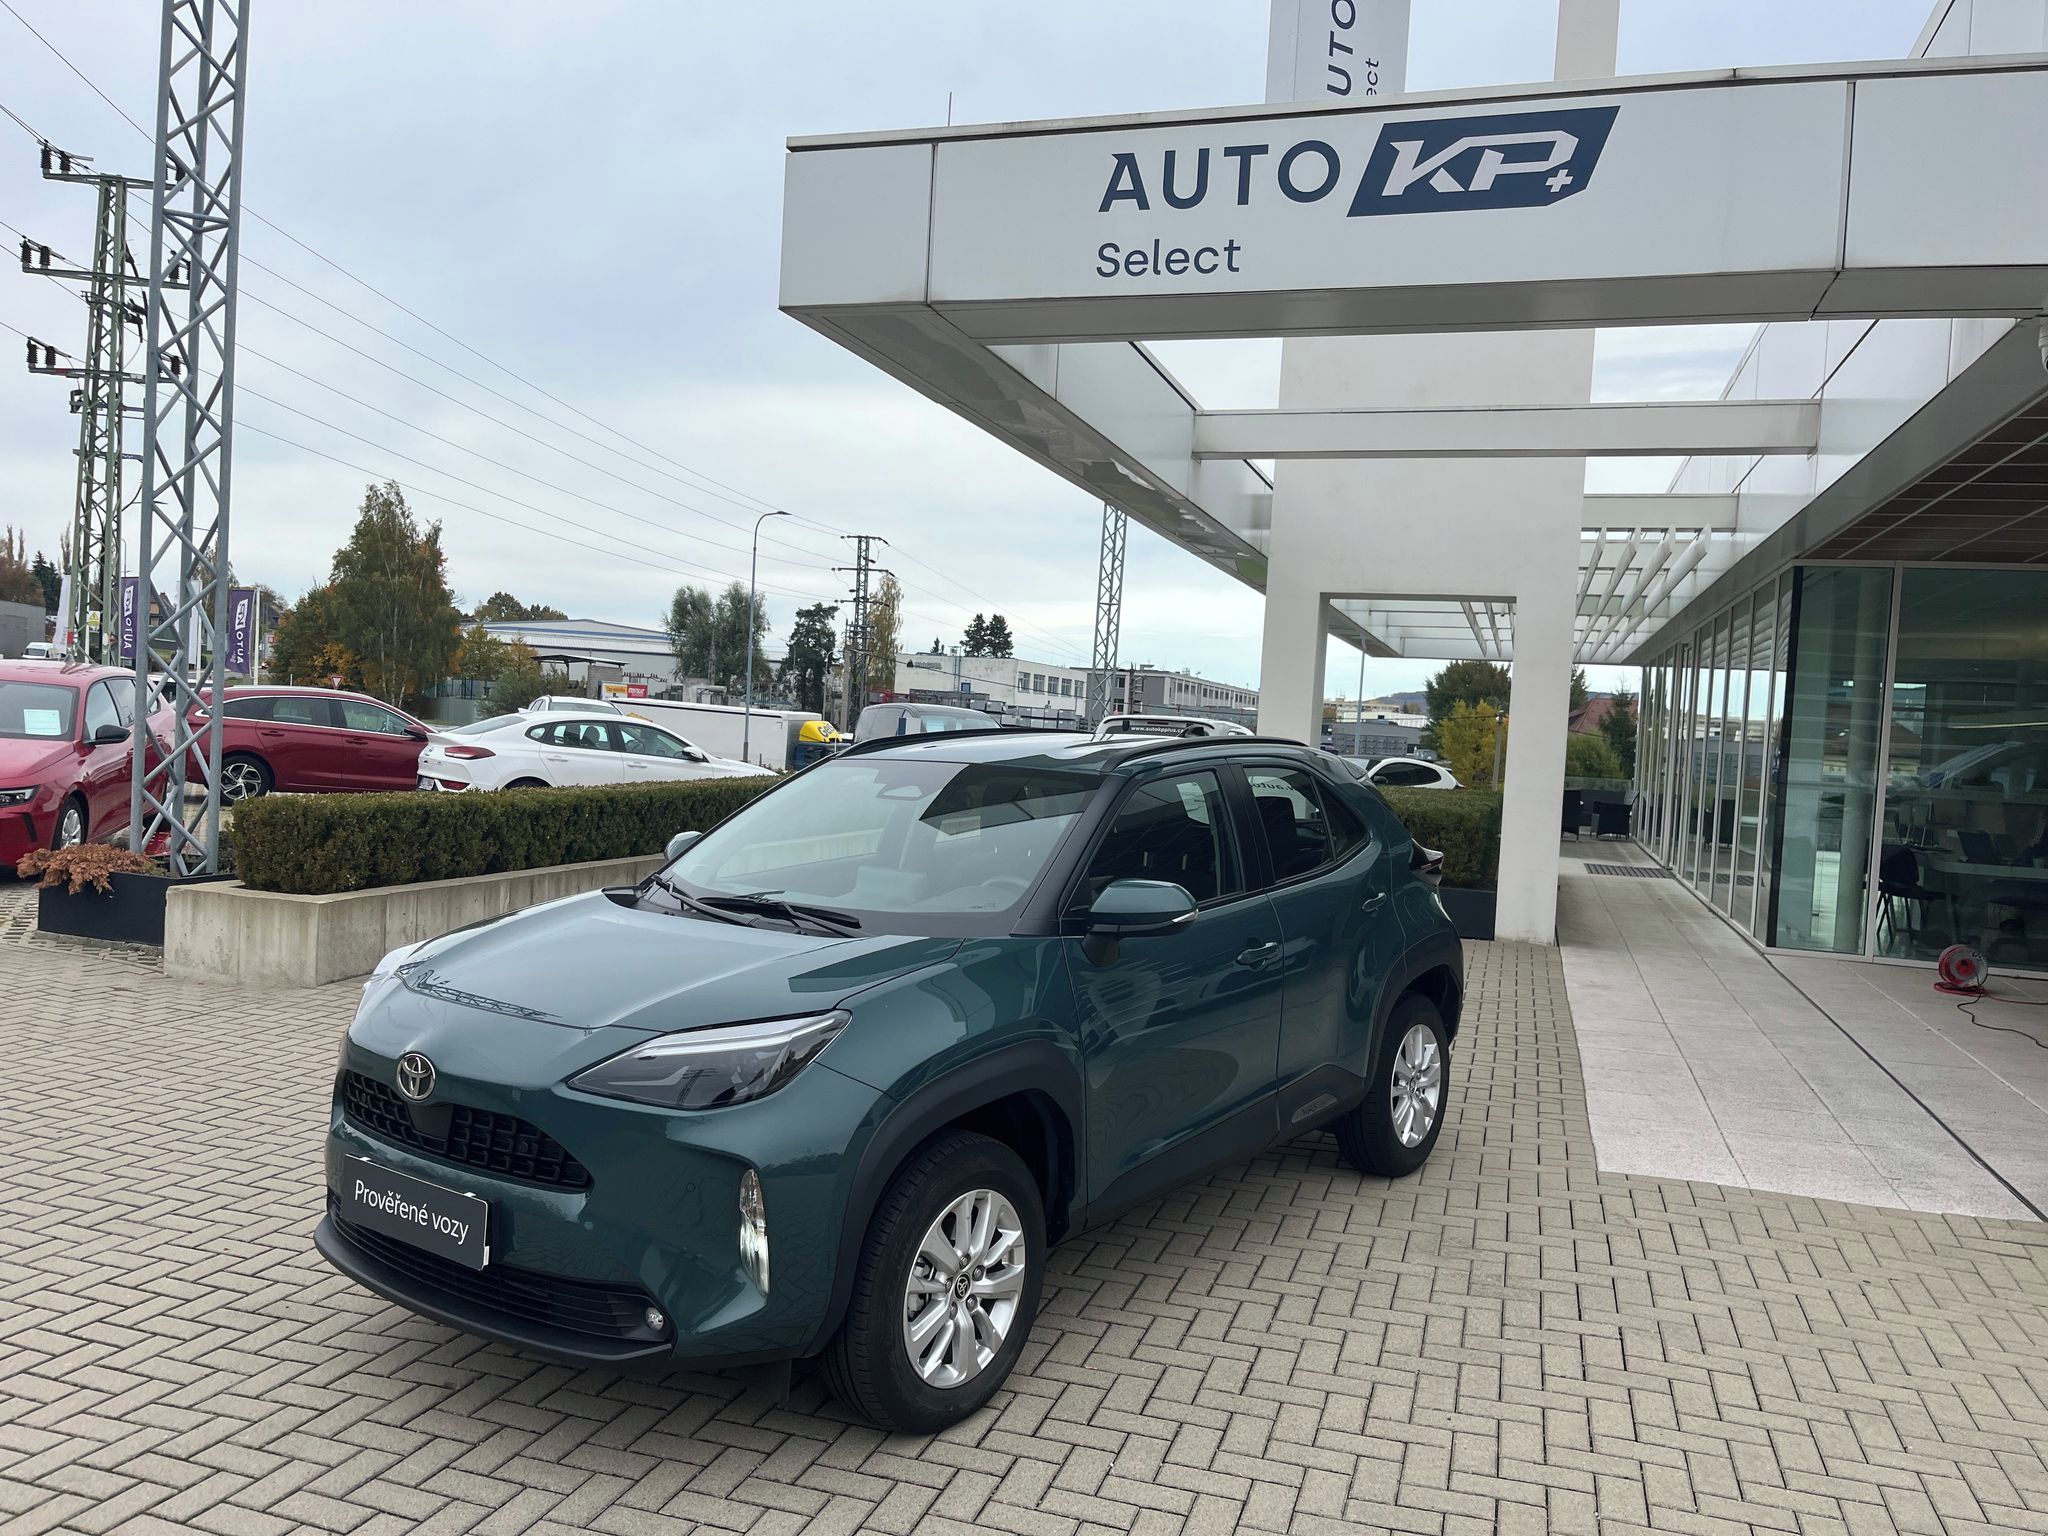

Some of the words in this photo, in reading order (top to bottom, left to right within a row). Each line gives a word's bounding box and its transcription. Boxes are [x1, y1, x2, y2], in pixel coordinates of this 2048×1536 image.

[1326, 0, 1357, 96] UTO
[1098, 139, 1342, 213] AUTO
[1095, 238, 1241, 278] Select
[354, 1179, 429, 1226] Prověřené
[431, 1212, 470, 1245] vozy
